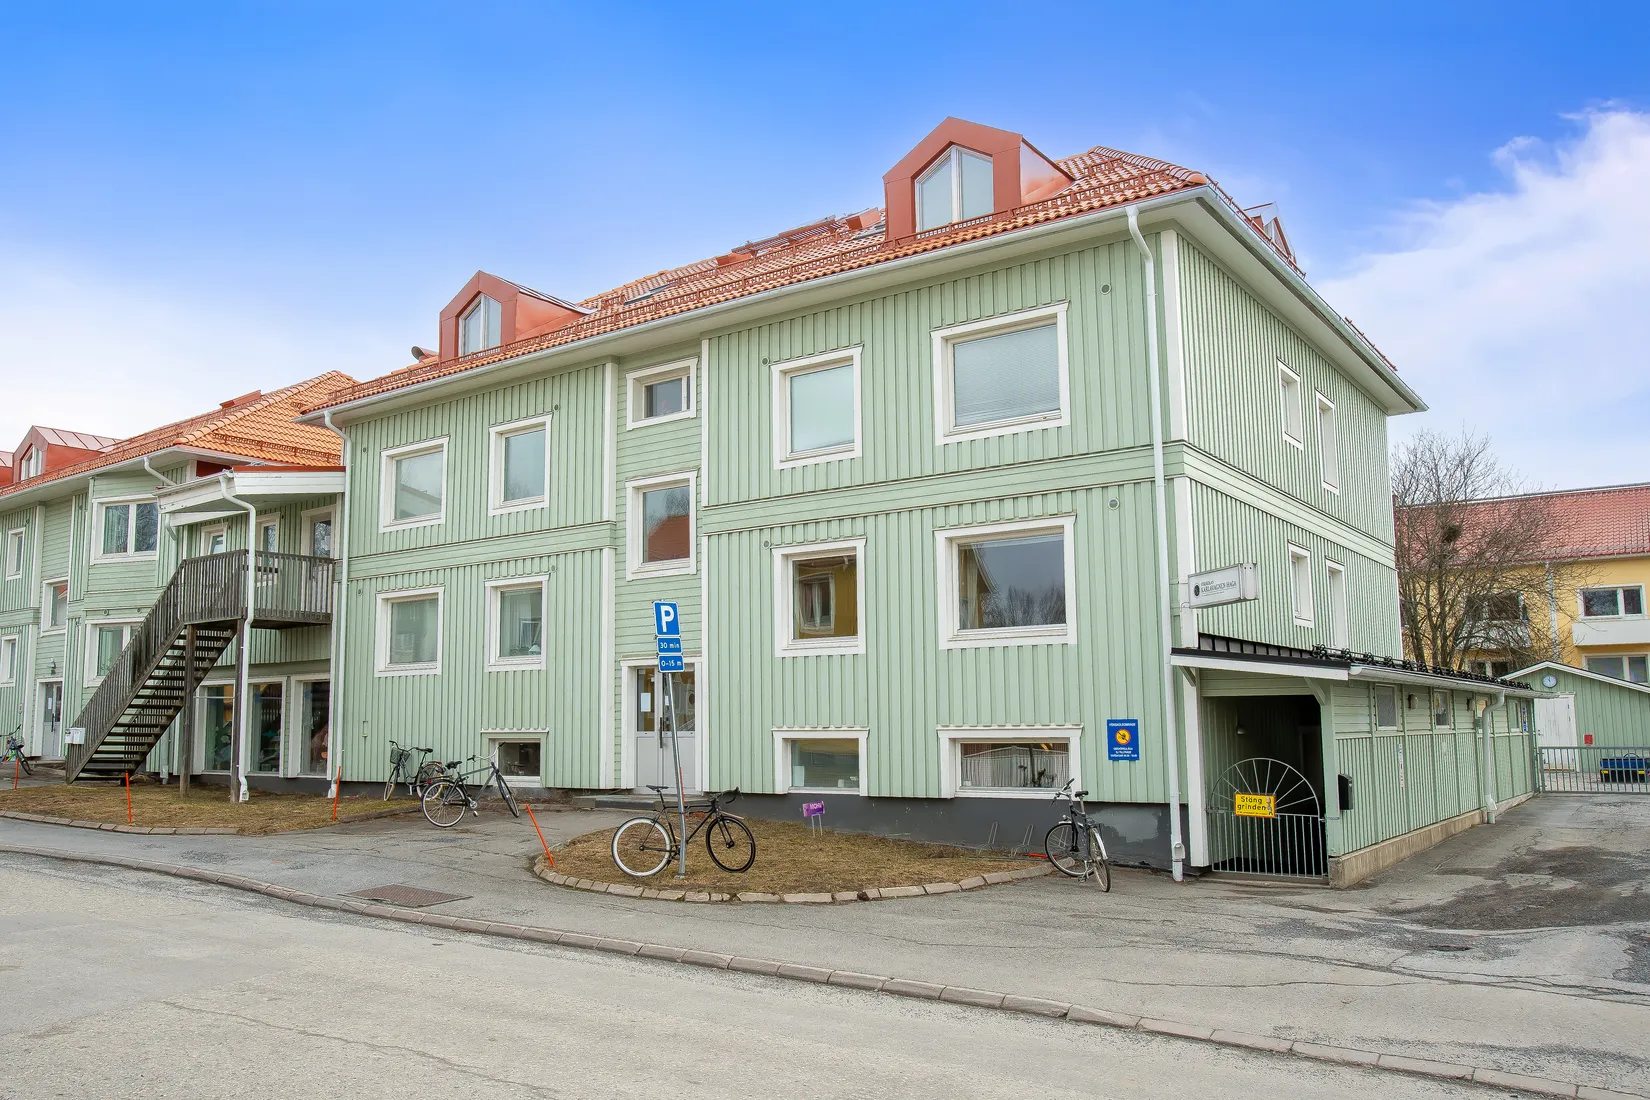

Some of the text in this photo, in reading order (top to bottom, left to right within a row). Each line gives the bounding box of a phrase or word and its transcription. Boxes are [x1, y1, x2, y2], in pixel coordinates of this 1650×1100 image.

[660, 605, 675, 633] P
[1240, 795, 1263, 805] Stäng
[1237, 803, 1266, 811] grinden
